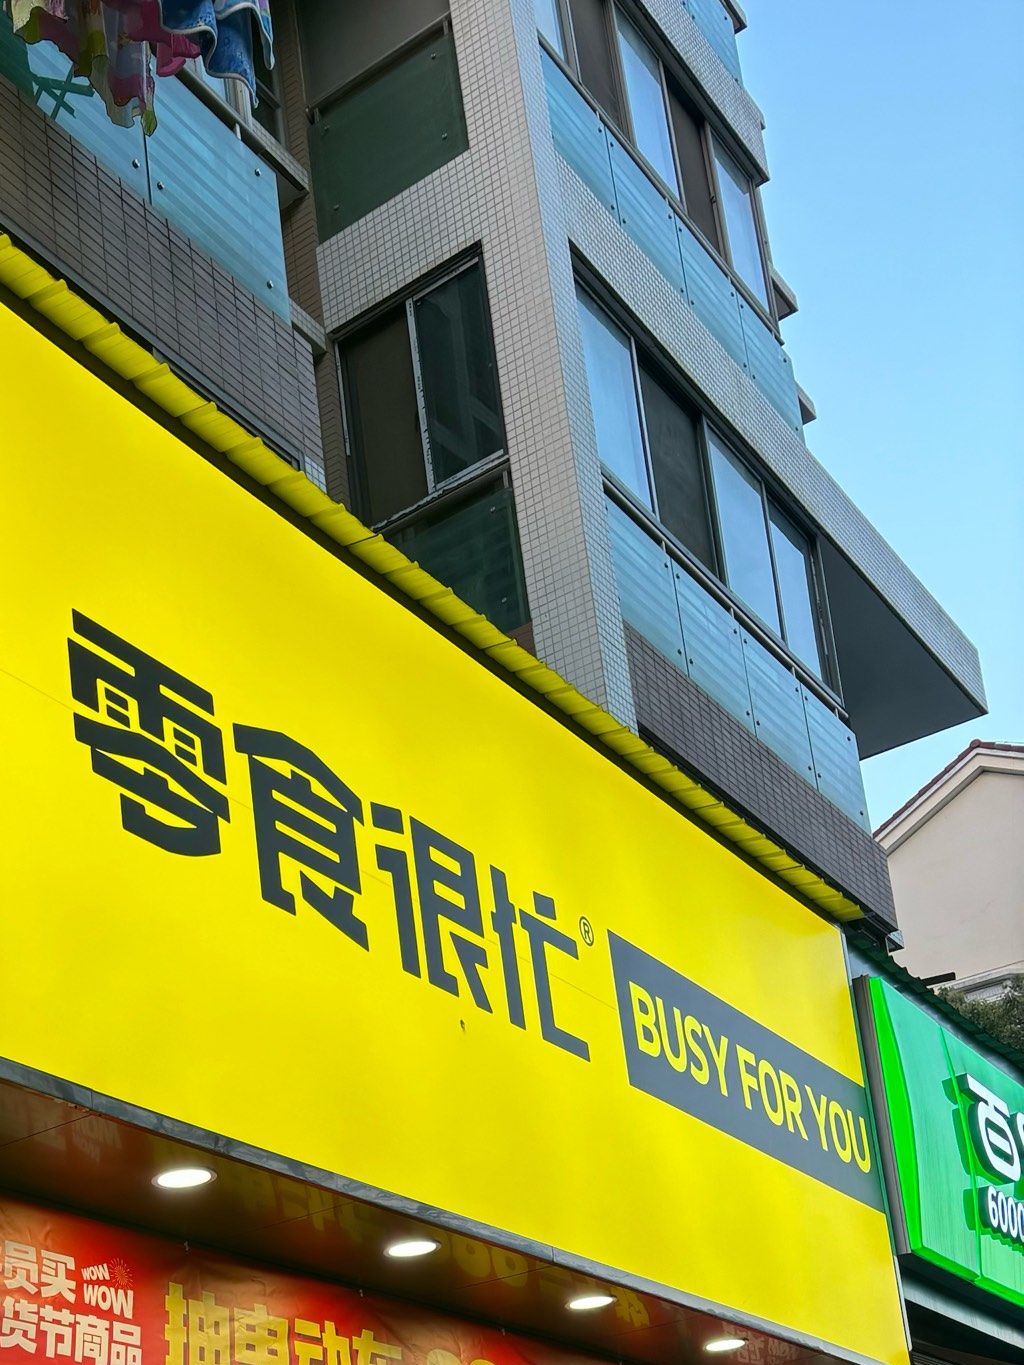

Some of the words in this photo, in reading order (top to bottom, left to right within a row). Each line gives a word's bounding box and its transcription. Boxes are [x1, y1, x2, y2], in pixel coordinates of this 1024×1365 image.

[67, 608, 591, 1062] 零食很忙
[631, 980, 731, 1098] BUSY
[739, 1044, 808, 1143] FOR
[810, 1093, 871, 1174] YOU
[81, 1262, 110, 1282] WOW
[83, 1283, 133, 1320] WOW
